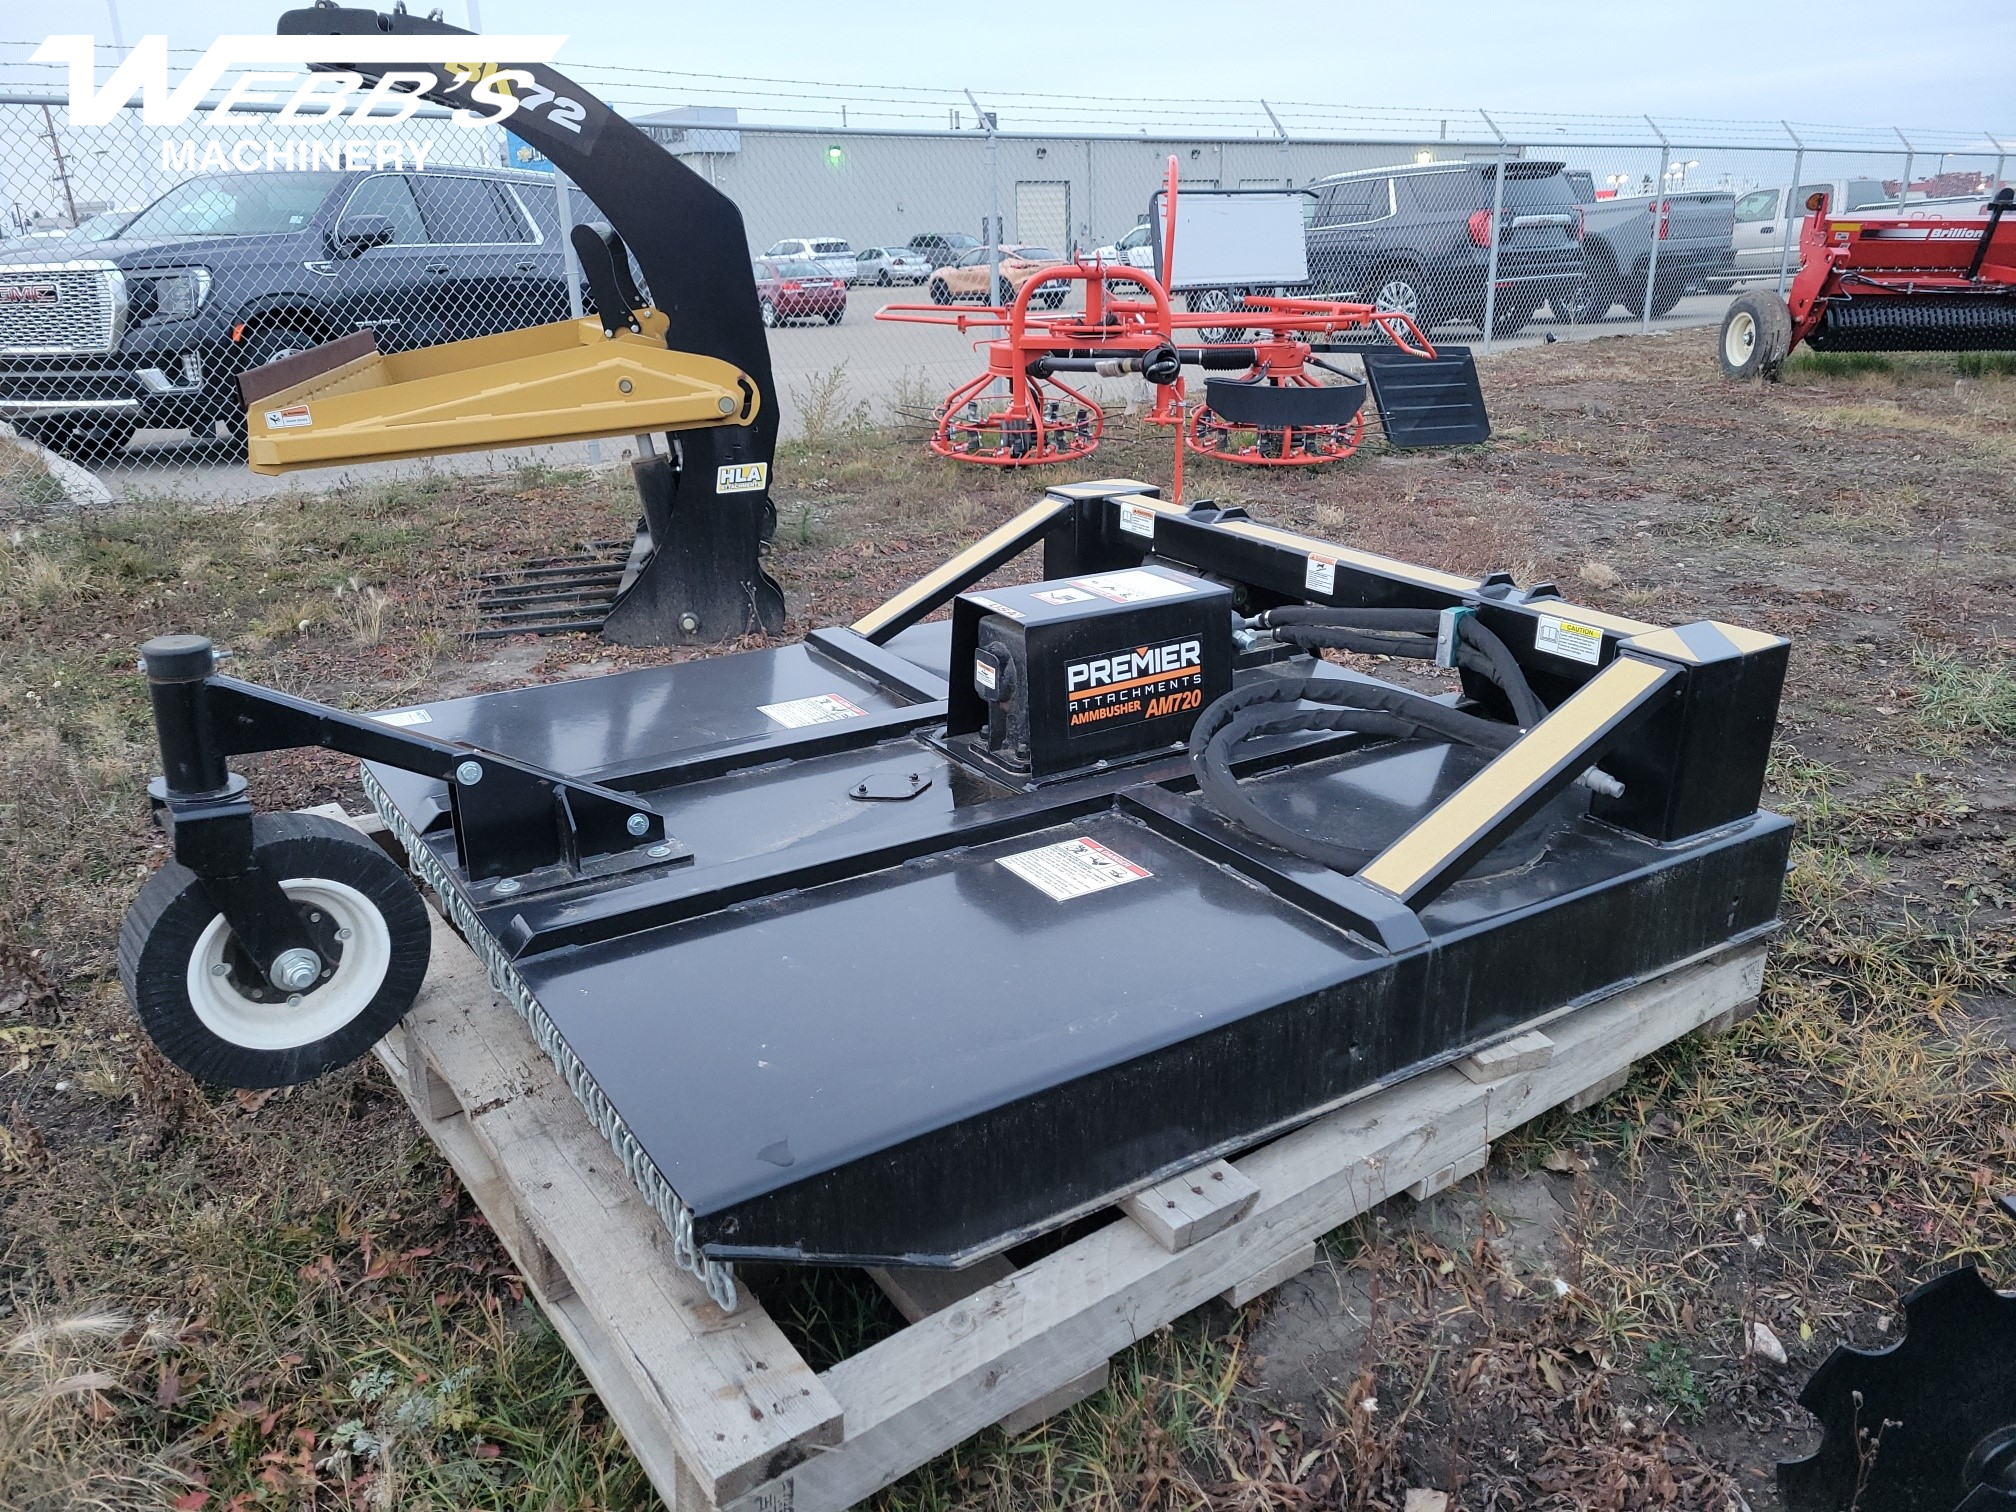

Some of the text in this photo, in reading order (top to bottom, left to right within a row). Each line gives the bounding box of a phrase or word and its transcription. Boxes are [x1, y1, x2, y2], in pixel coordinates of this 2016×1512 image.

[1930, 228, 1985, 238] Brillion
[721, 466, 762, 484] HLA
[1566, 624, 1594, 636] CAUTION
[1067, 640, 1201, 692] PREMIER
[1069, 674, 1202, 712] ATTACHMENTS
[1070, 688, 1202, 726] AMMBUSHER AM720
